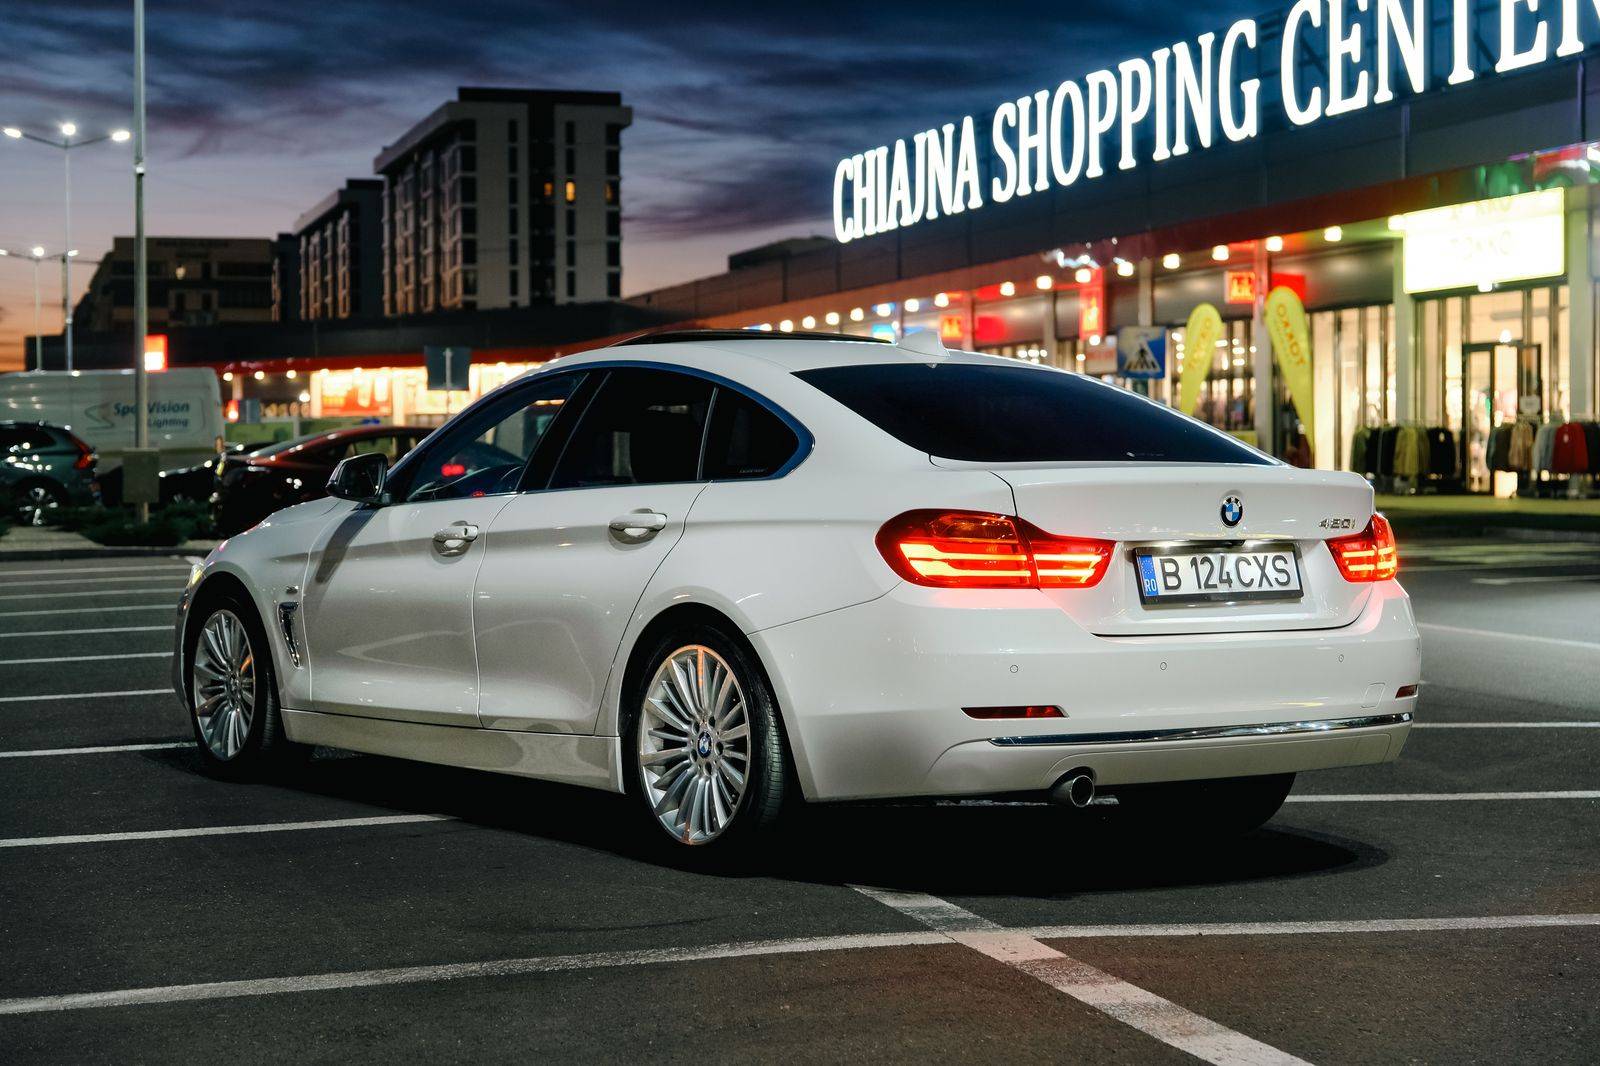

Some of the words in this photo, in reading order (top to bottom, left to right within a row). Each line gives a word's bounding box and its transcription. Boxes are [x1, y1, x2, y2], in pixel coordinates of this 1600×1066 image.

[833, 115, 983, 244] CHIAJNA
[992, 19, 1260, 202] SHOPPING
[1318, 518, 1357, 529] 420i
[1144, 578, 1157, 592] RO
[1159, 557, 1182, 591] B
